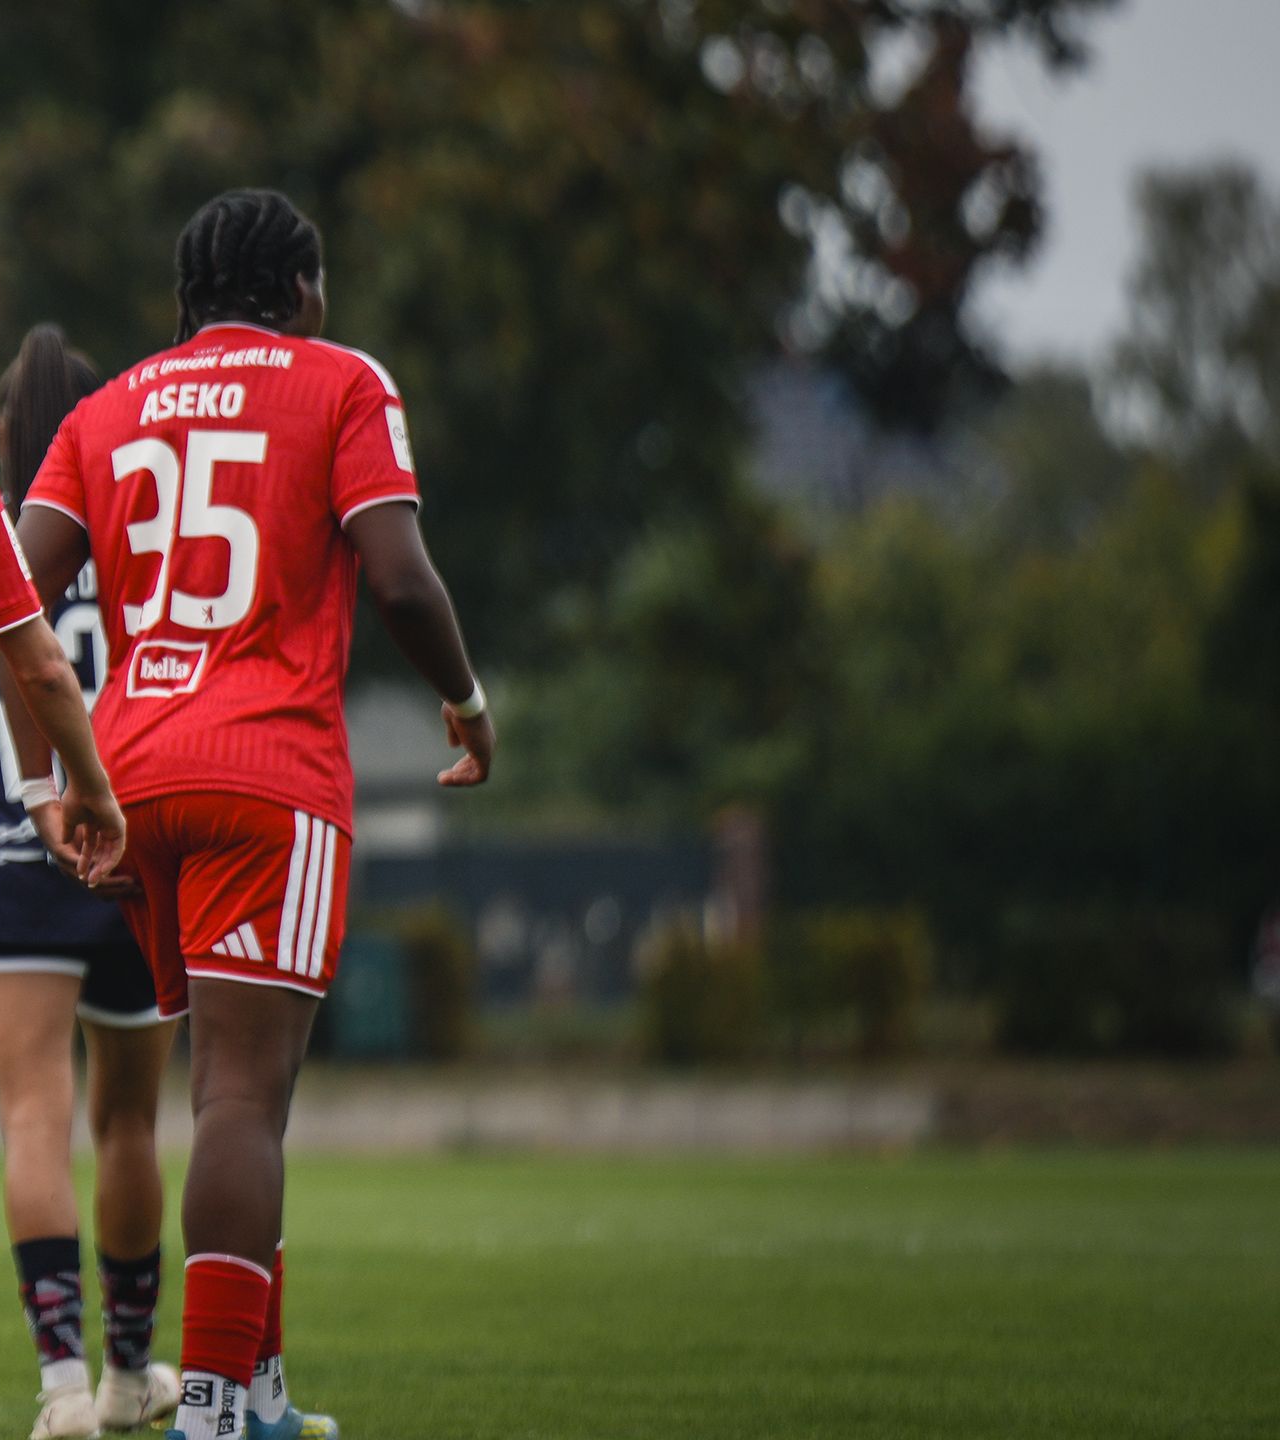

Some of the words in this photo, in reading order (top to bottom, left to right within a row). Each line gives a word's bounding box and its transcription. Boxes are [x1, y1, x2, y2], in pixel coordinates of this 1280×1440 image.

[140, 362, 160, 384] FC
[160, 355, 218, 375] UNION
[220, 347, 293, 369] BERLIN
[139, 382, 245, 426] ASEKO
[111, 431, 268, 637] 35
[140, 656, 190, 680] bella
[180, 1381, 208, 1405] S
